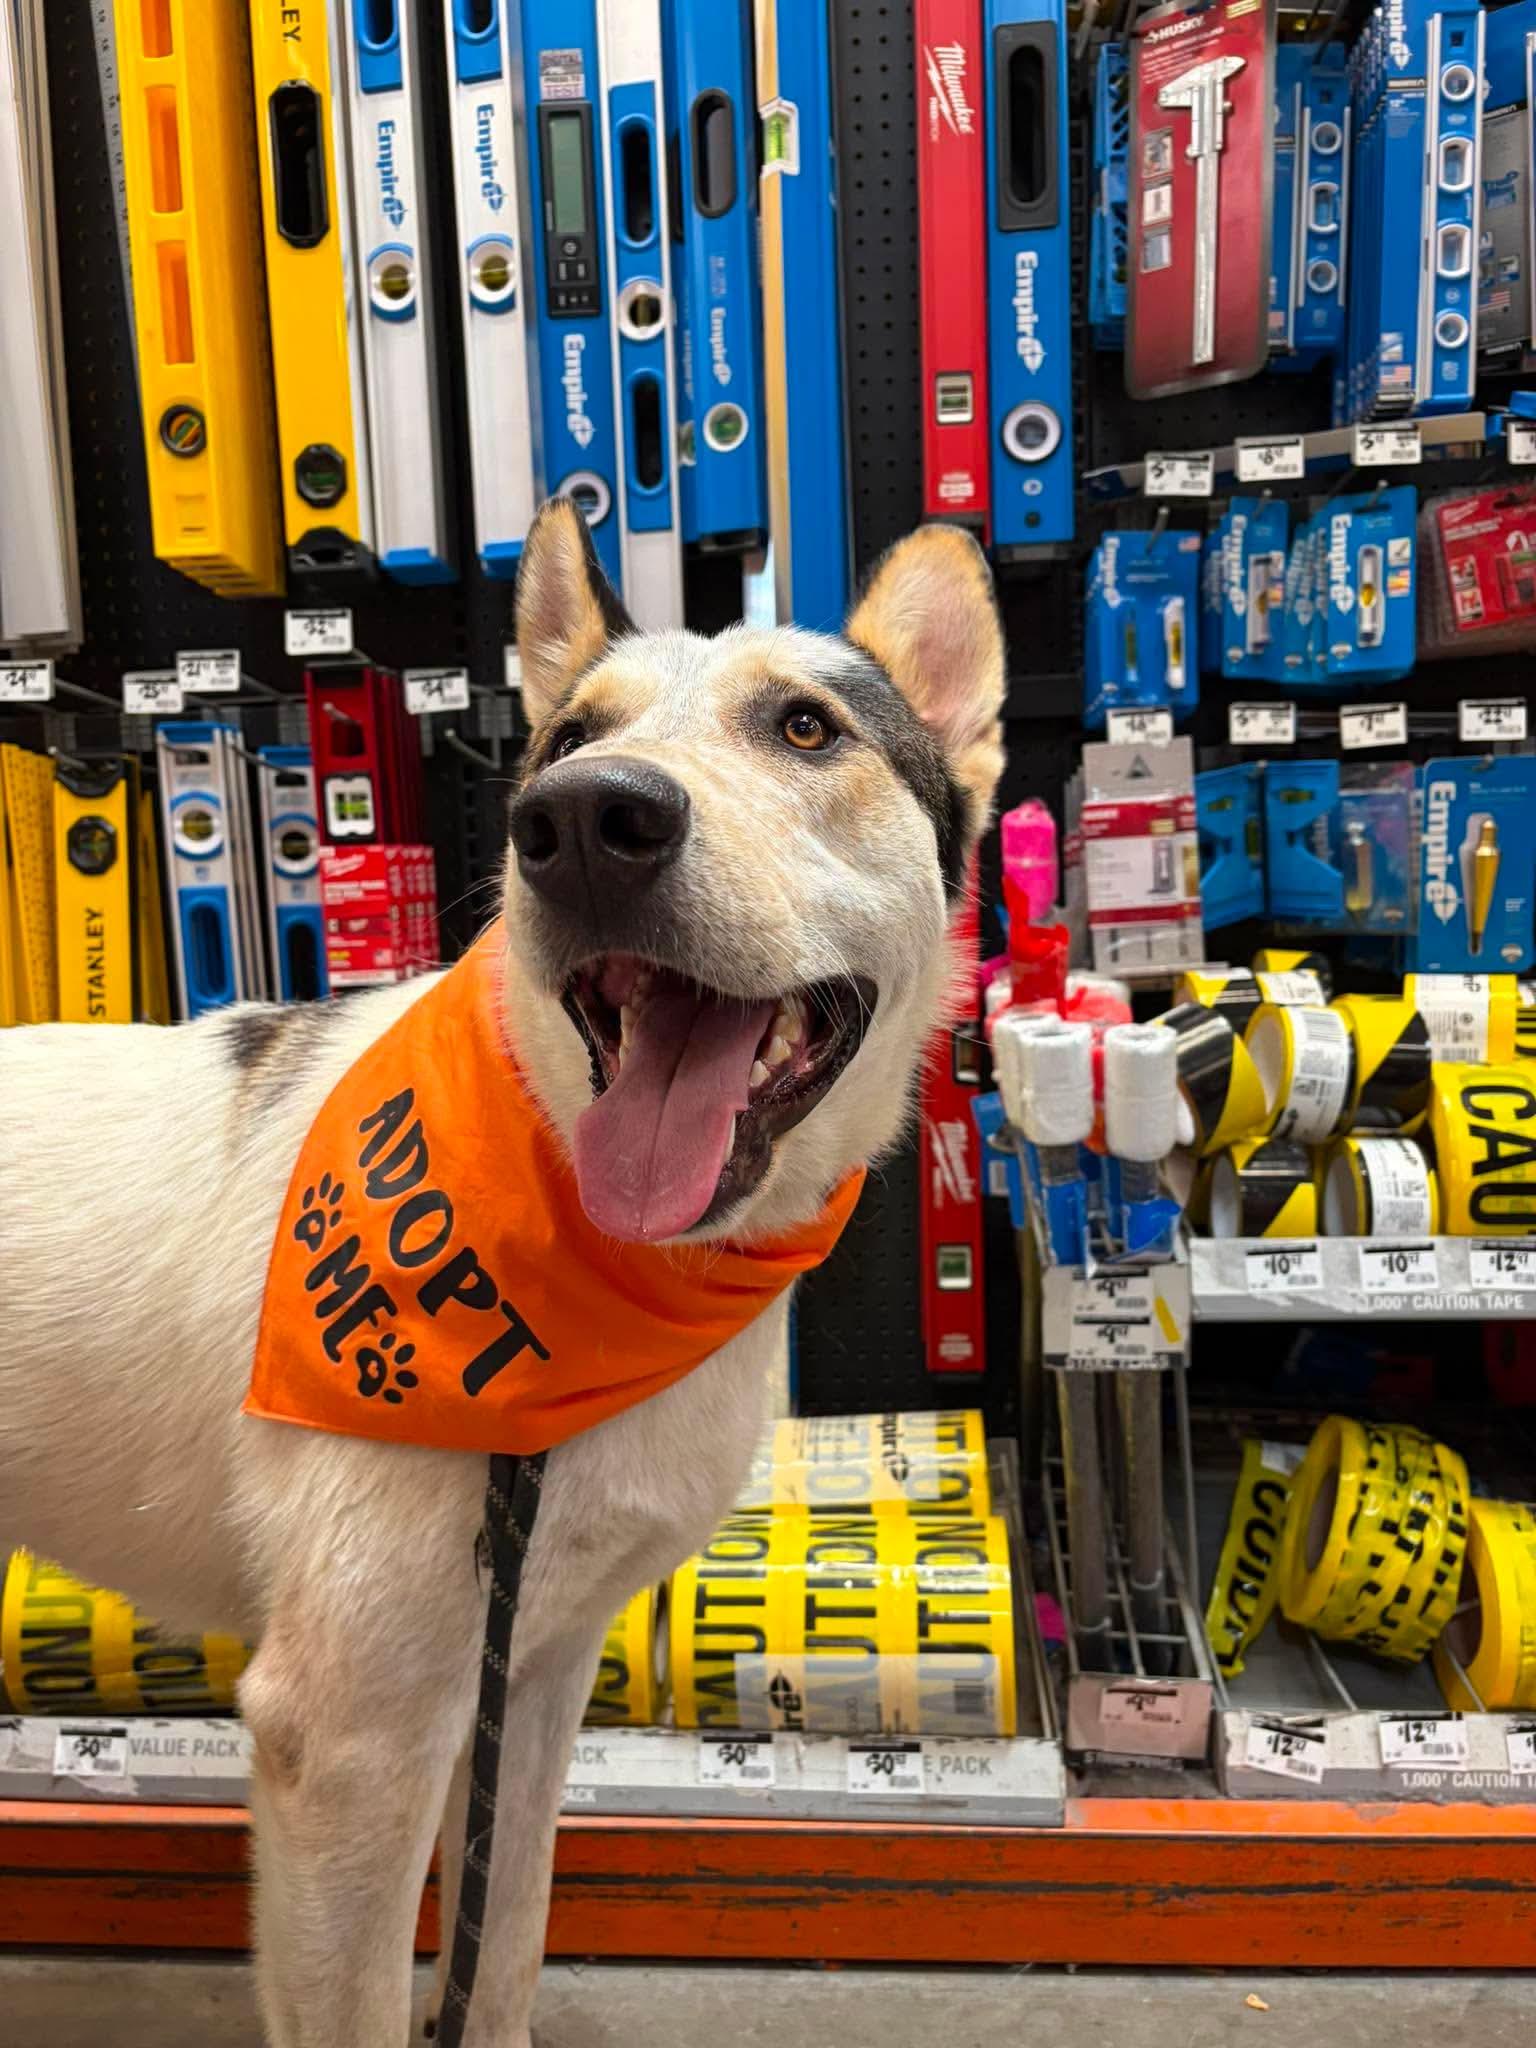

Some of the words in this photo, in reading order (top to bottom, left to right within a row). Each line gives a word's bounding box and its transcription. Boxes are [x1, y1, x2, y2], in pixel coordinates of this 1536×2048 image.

[376, 119, 408, 231] Empire
[474, 103, 507, 215] Empire
[709, 307, 732, 387] Empire
[1011, 251, 1047, 375] Empire
[561, 333, 596, 448] Empire
[1327, 513, 1356, 615] Empire
[1421, 781, 1464, 925] Empire
[86, 907, 106, 1018] STANLEY
[358, 1087, 551, 1397] ADOPT
[304, 1234, 398, 1364] ME
[1413, 1295, 1480, 1311] CAUTION
[1486, 1295, 1524, 1310] TAPE
[130, 1738, 187, 1757] VALUE
[191, 1739, 240, 1757] PACK
[940, 1755, 993, 1775] PACK
[1452, 1773, 1522, 1788] CAUTION
